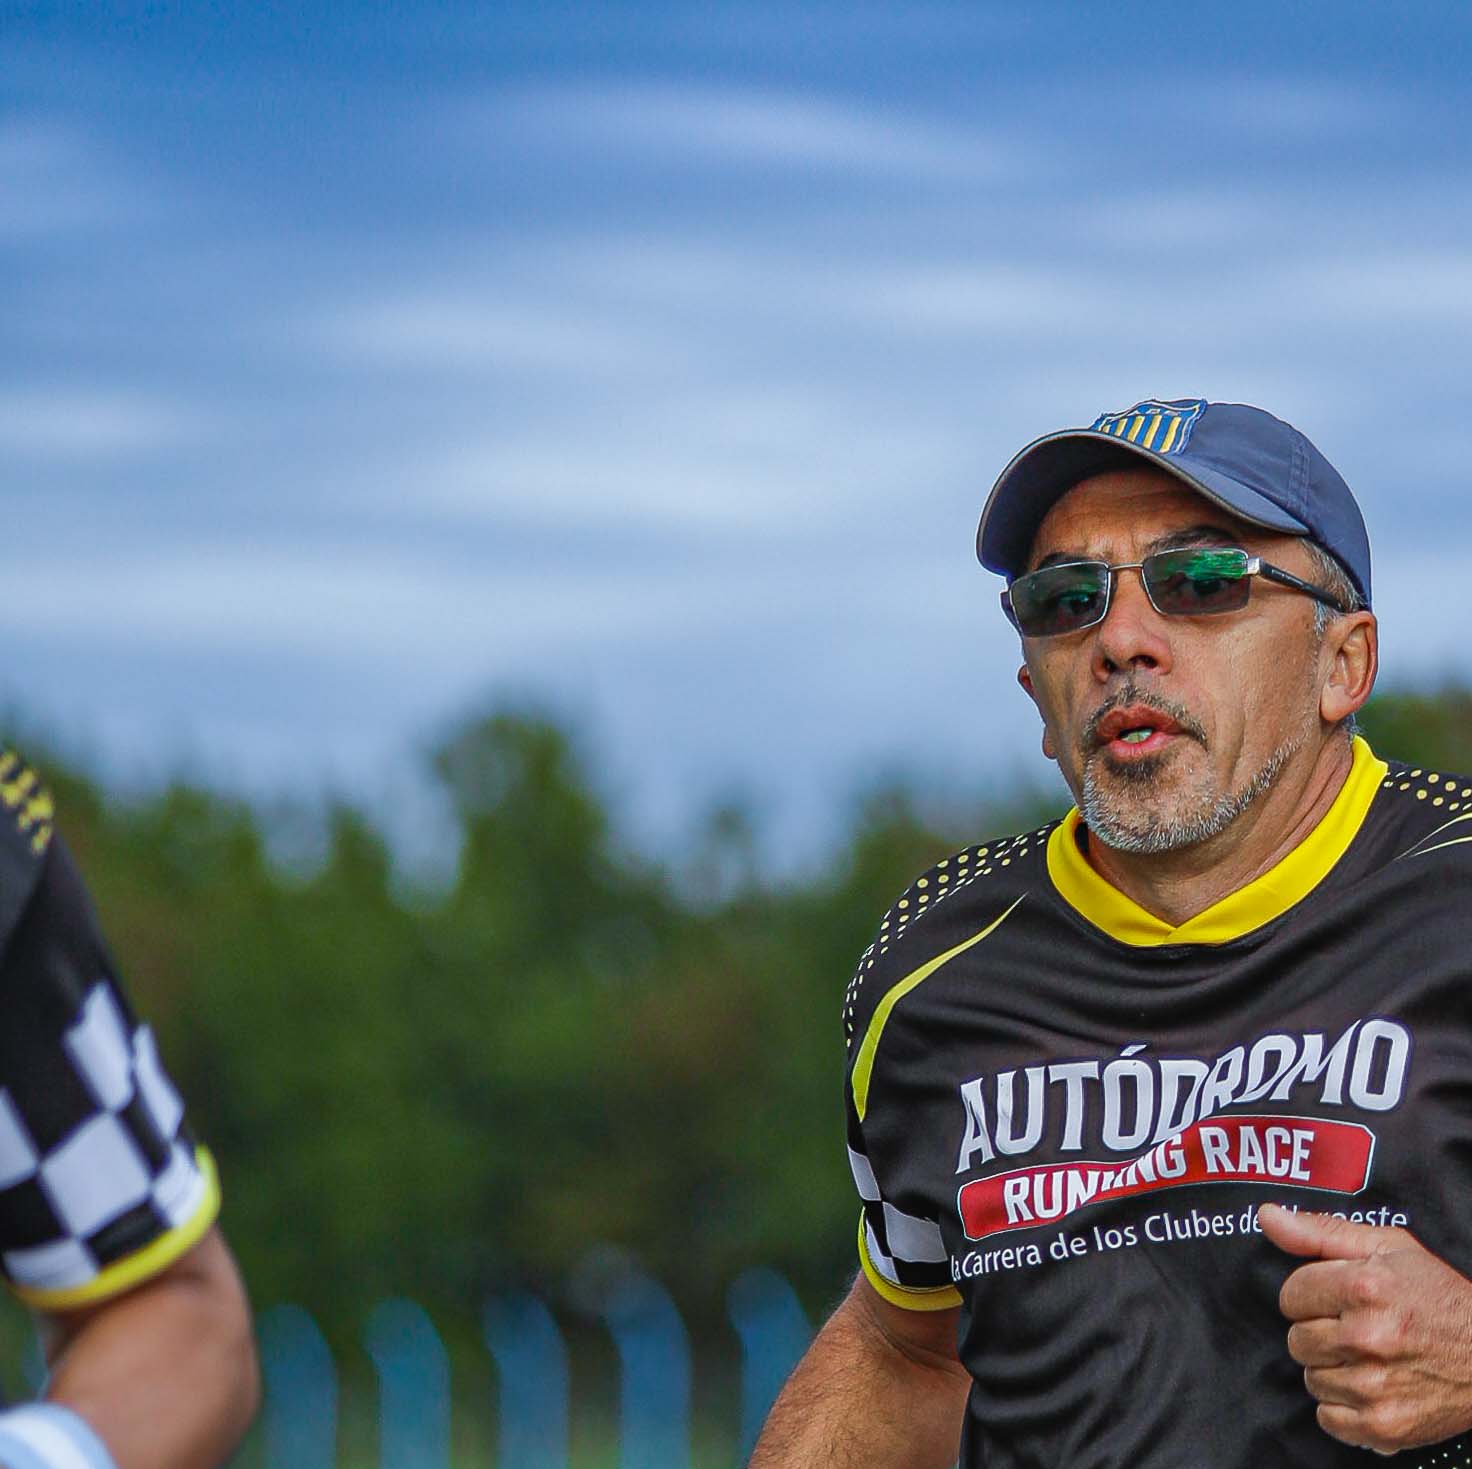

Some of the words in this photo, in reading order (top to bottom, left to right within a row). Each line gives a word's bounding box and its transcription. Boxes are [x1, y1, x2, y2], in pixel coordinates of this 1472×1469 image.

[954, 1018, 1410, 1175] AUTÓDROMO
[1200, 1125, 1316, 1181] RACE
[962, 1241, 1042, 1279] Carrera
[1049, 1232, 1088, 1261] de
[1093, 1225, 1139, 1252] los
[1144, 1208, 1234, 1243] Clubes
[1239, 1204, 1263, 1234] de
